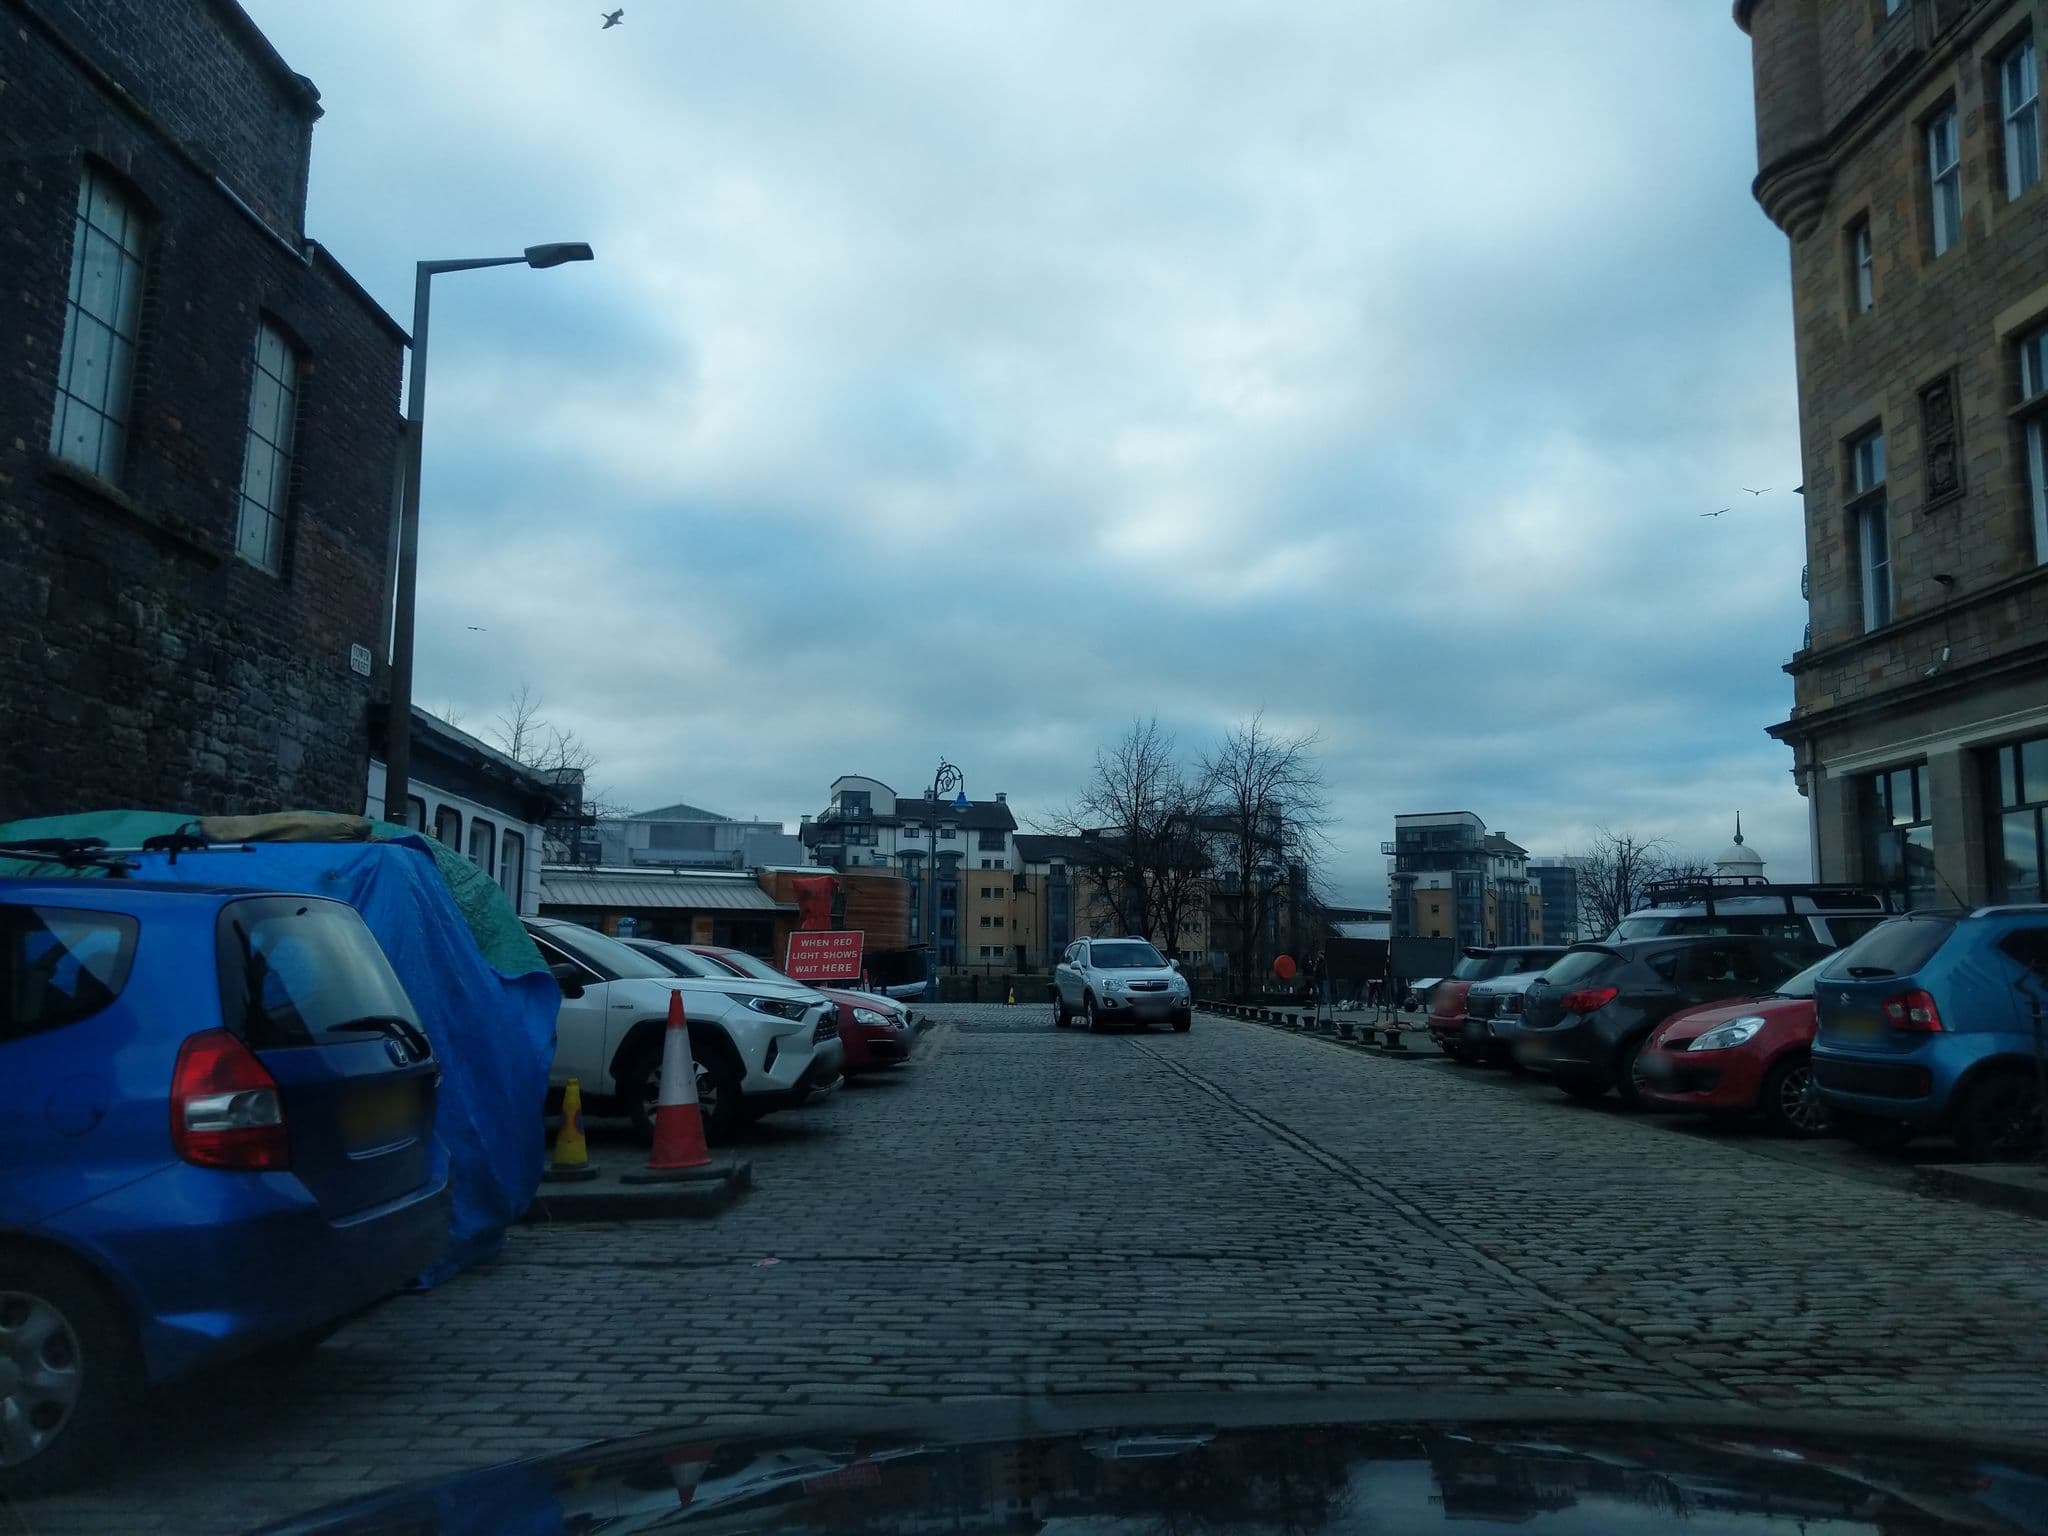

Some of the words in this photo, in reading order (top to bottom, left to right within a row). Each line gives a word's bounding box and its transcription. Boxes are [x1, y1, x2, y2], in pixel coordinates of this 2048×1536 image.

[801, 939, 830, 947] WHEN
[833, 938, 852, 946] RED
[792, 952, 820, 960] LIGHT
[823, 950, 858, 959] SHOWS
[795, 965, 818, 973] WAIT
[822, 963, 852, 972] HERE
